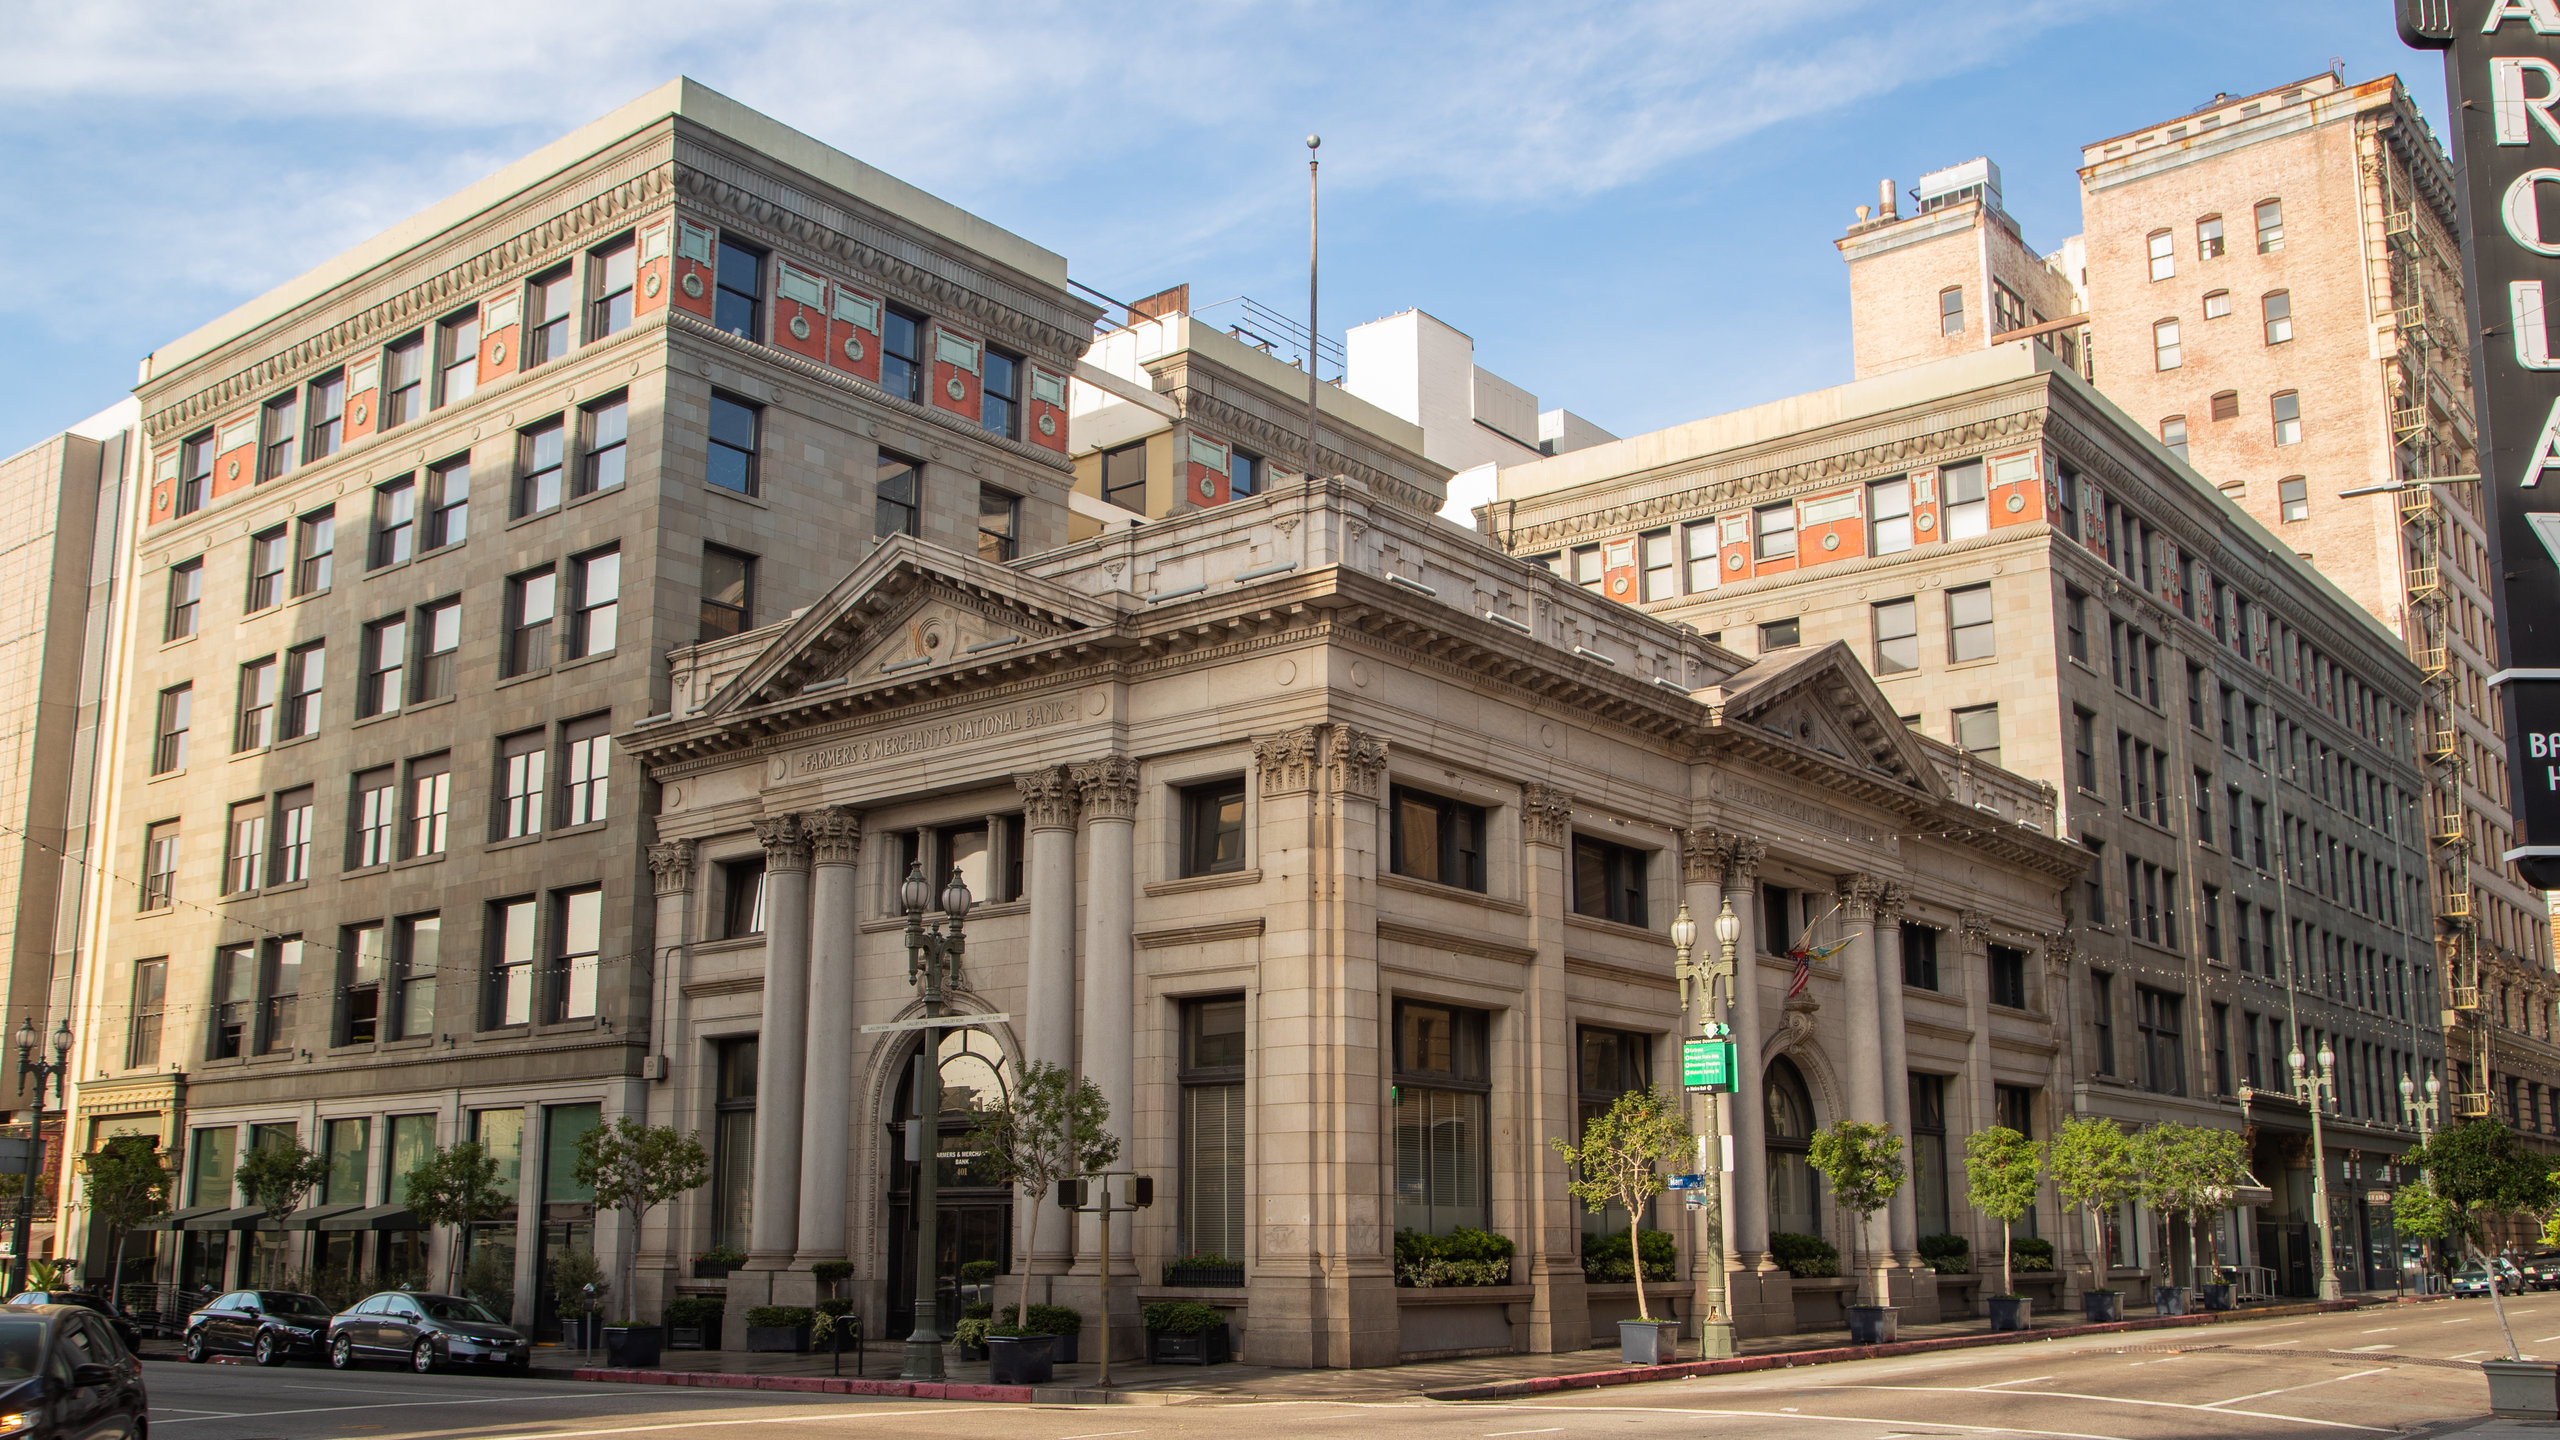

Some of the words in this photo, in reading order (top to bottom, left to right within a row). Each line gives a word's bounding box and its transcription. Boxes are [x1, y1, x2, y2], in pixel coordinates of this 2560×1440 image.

[805, 744, 857, 772] FARMERS
[861, 742, 870, 760] &
[872, 724, 952, 759] MERCHANTS
[955, 711, 1021, 742] NATIONAL
[1025, 701, 1064, 728] BANK
[45, 1135, 58, 1185] PARKING
